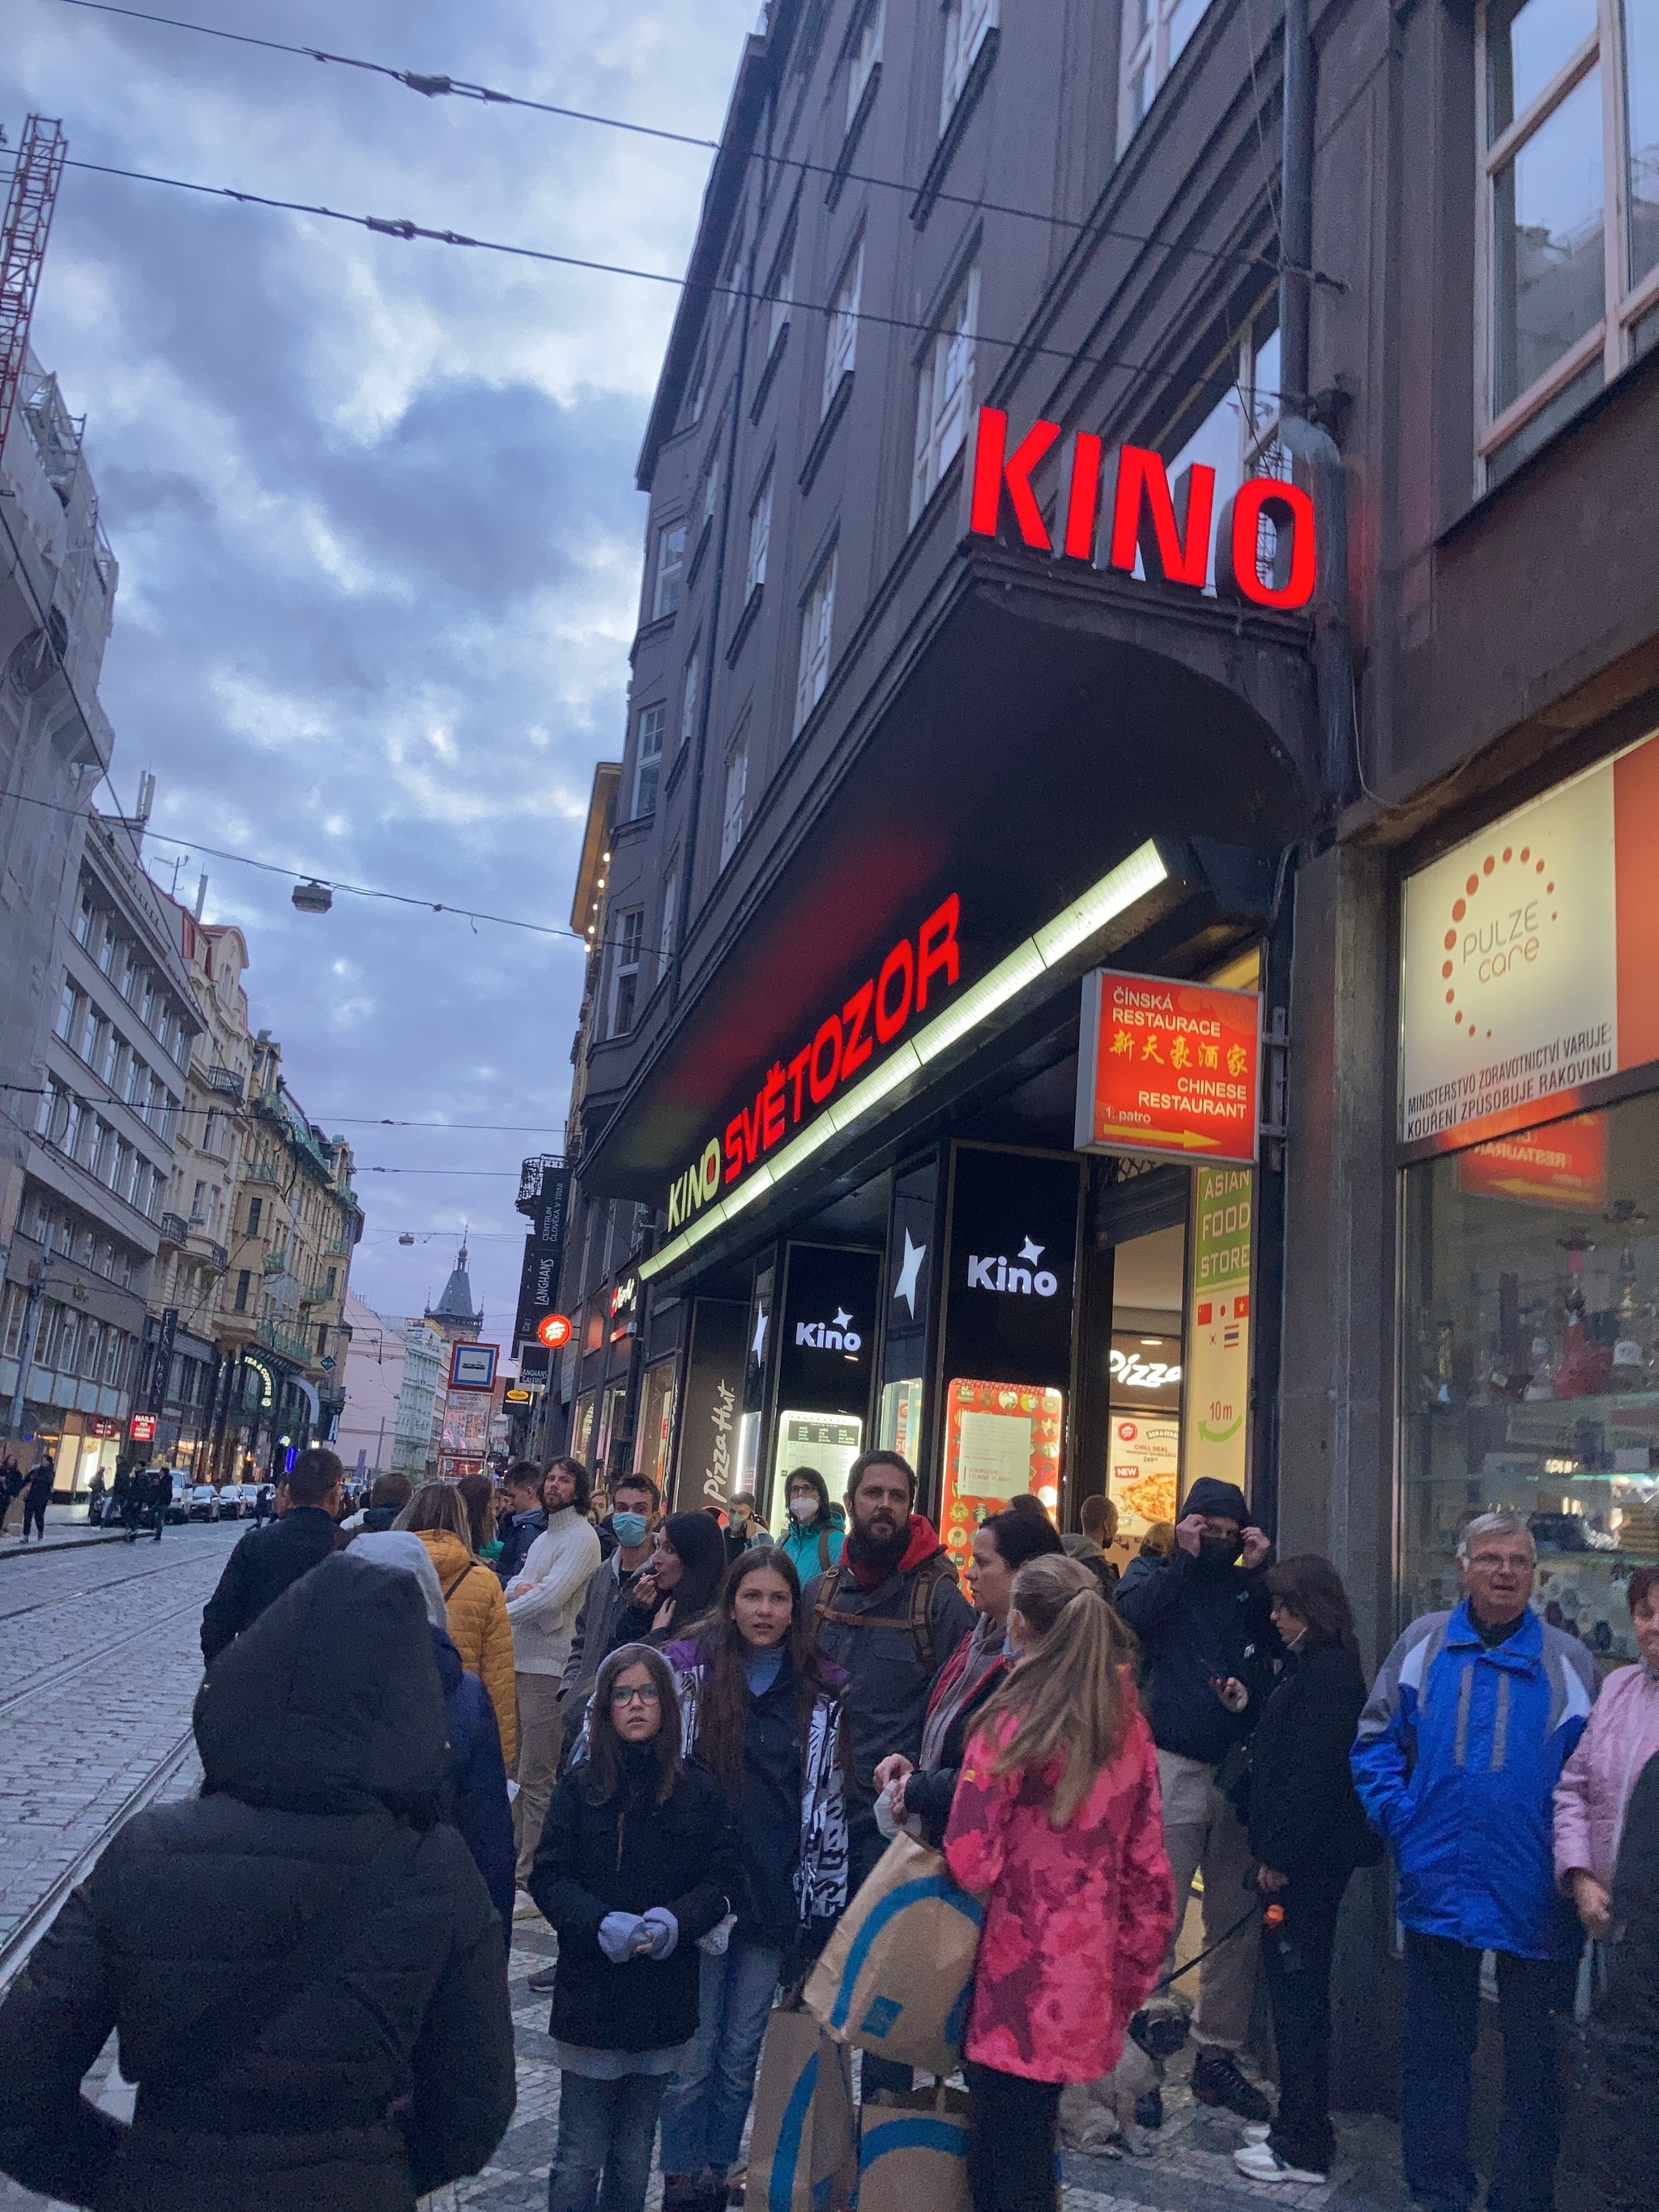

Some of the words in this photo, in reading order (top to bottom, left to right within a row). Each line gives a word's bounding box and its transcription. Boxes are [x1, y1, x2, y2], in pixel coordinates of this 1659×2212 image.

[970, 405, 1316, 609] KINO
[1463, 899, 1539, 964] PULZE
[1478, 936, 1539, 984] care
[1112, 985, 1174, 1012] ČÍNSKÁ
[1112, 1007, 1221, 1038] RESTAURACE
[667, 1137, 720, 1233] KINO
[724, 892, 959, 1183] SVĚTOZOR
[1109, 1028, 1248, 1077] 新天豪酒家
[1177, 1076, 1247, 1101] CHINESE
[1407, 1102, 1457, 1140] KOUŘENÍ
[1539, 1050, 1612, 1095] RAKOVINU
[1408, 1072, 1476, 1115] MINISTERSTVO
[1479, 1037, 1559, 1089] ZDRAVOTNICTVÍ
[1105, 1106, 1115, 1120] 1.
[1119, 1108, 1151, 1124] patro
[1138, 1090, 1247, 1120] RESTAURANT
[1205, 1169, 1251, 1200] ASIAN
[543, 1206, 552, 1242] CENTRUM
[1203, 1201, 1251, 1241] FOOD
[967, 1255, 1058, 1297] Kino
[1201, 1243, 1250, 1278] STORE
[534, 1259, 554, 1306] LANGHANS
[796, 1321, 861, 1352] Kino
[244, 1356, 258, 1366] TEA
[261, 1368, 271, 1396] COFFEE
[134, 1414, 156, 1424] NAILS
[711, 1379, 736, 1431] Hut
[1209, 1400, 1222, 1421] 10
[1134, 1444, 1151, 1452] CHILL
[1153, 1445, 1168, 1453] DEAL
[703, 1433, 731, 1503] Pizza
[1117, 1468, 1137, 1477] NEW
